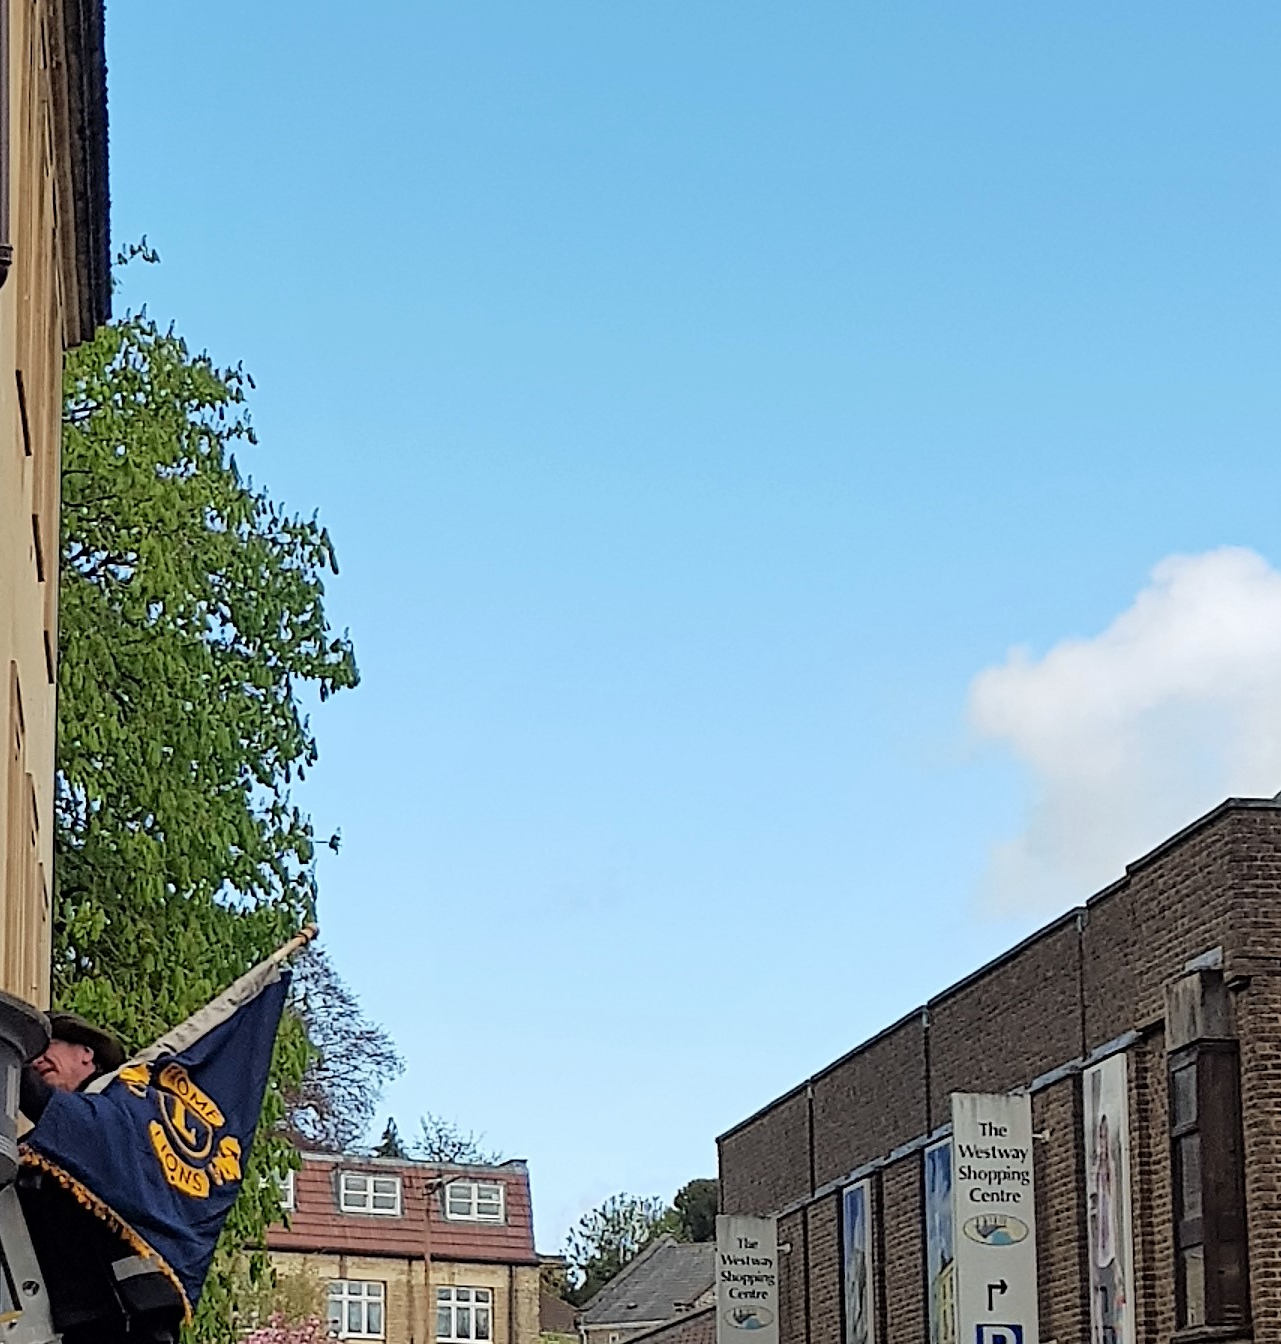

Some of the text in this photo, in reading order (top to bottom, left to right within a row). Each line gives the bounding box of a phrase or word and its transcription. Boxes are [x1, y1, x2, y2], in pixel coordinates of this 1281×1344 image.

[978, 1122, 1008, 1138] The
[958, 1144, 1029, 1164] Westway
[958, 1165, 1031, 1186] Shopping
[969, 1188, 1022, 1204] Centre
[736, 1237, 760, 1250] The
[720, 1254, 774, 1269] Westway
[720, 1270, 776, 1287] Shopping
[728, 1287, 769, 1300] Centre
